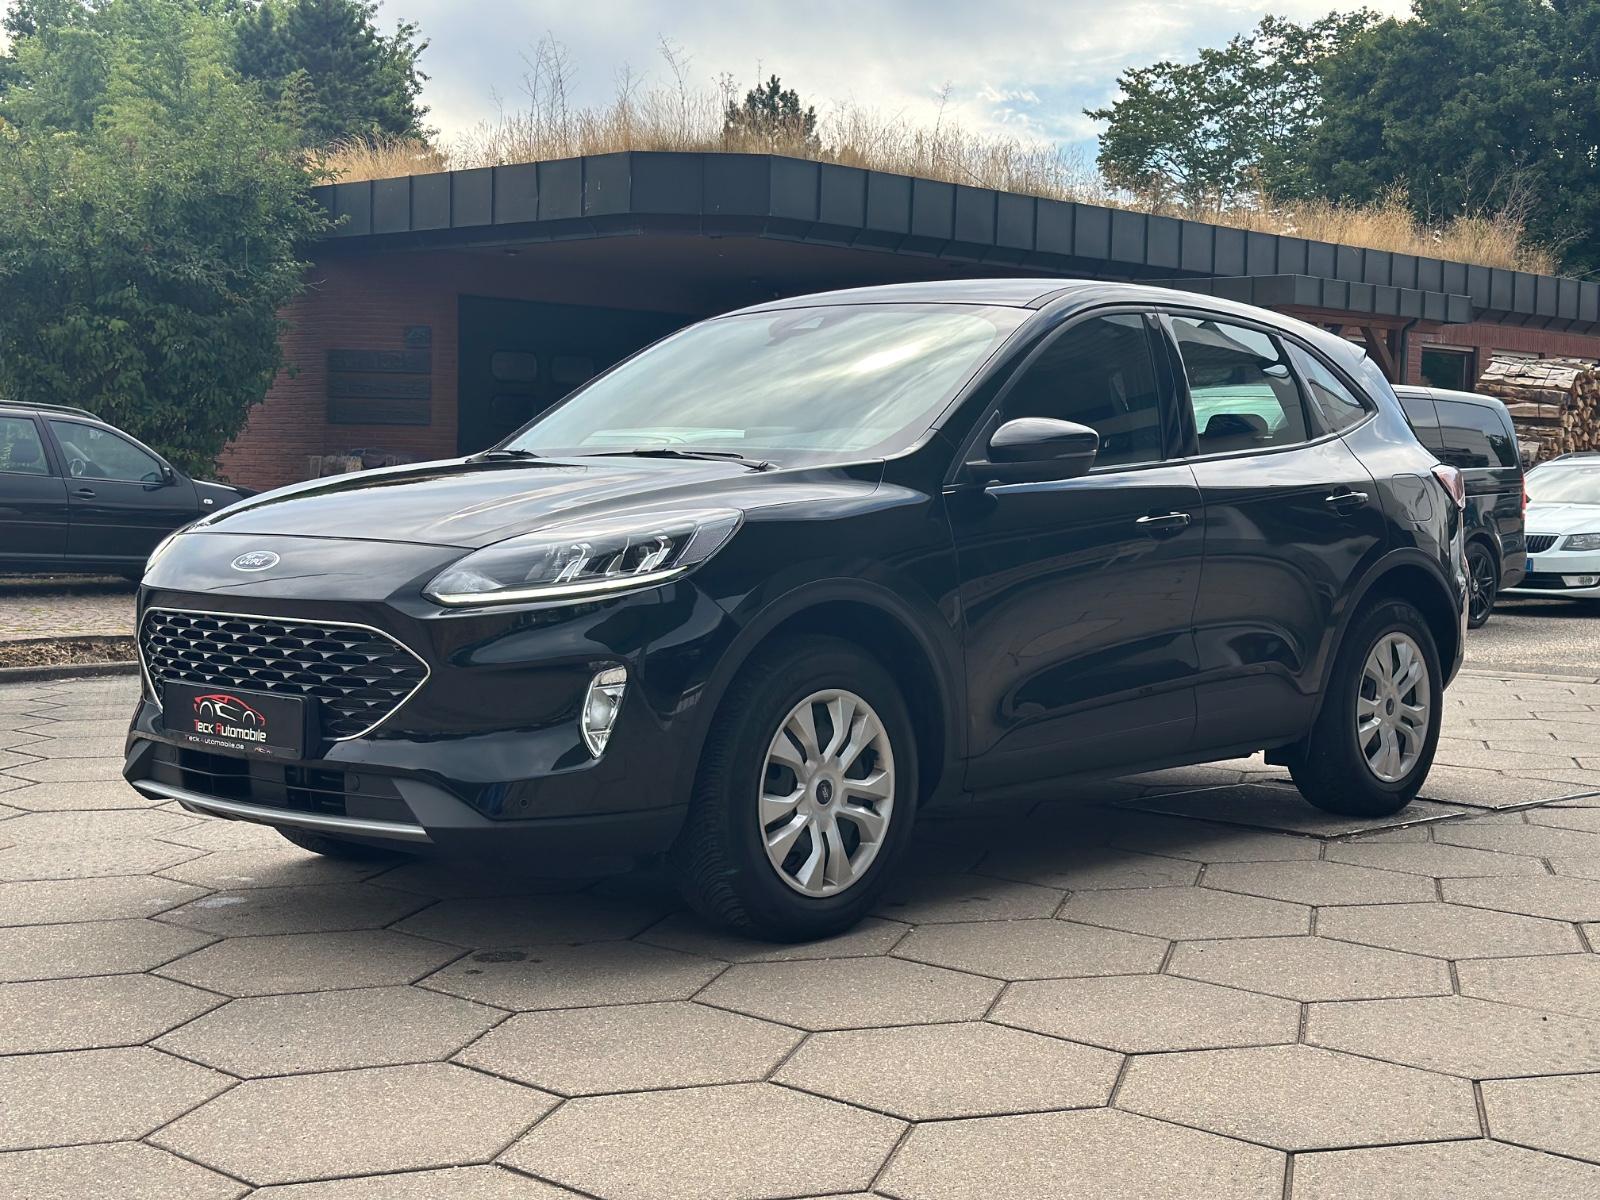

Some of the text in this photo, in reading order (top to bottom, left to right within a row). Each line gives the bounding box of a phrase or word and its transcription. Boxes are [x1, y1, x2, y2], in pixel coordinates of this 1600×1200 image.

[239, 552, 270, 566] Ford
[194, 719, 267, 742] Teck Automobile
